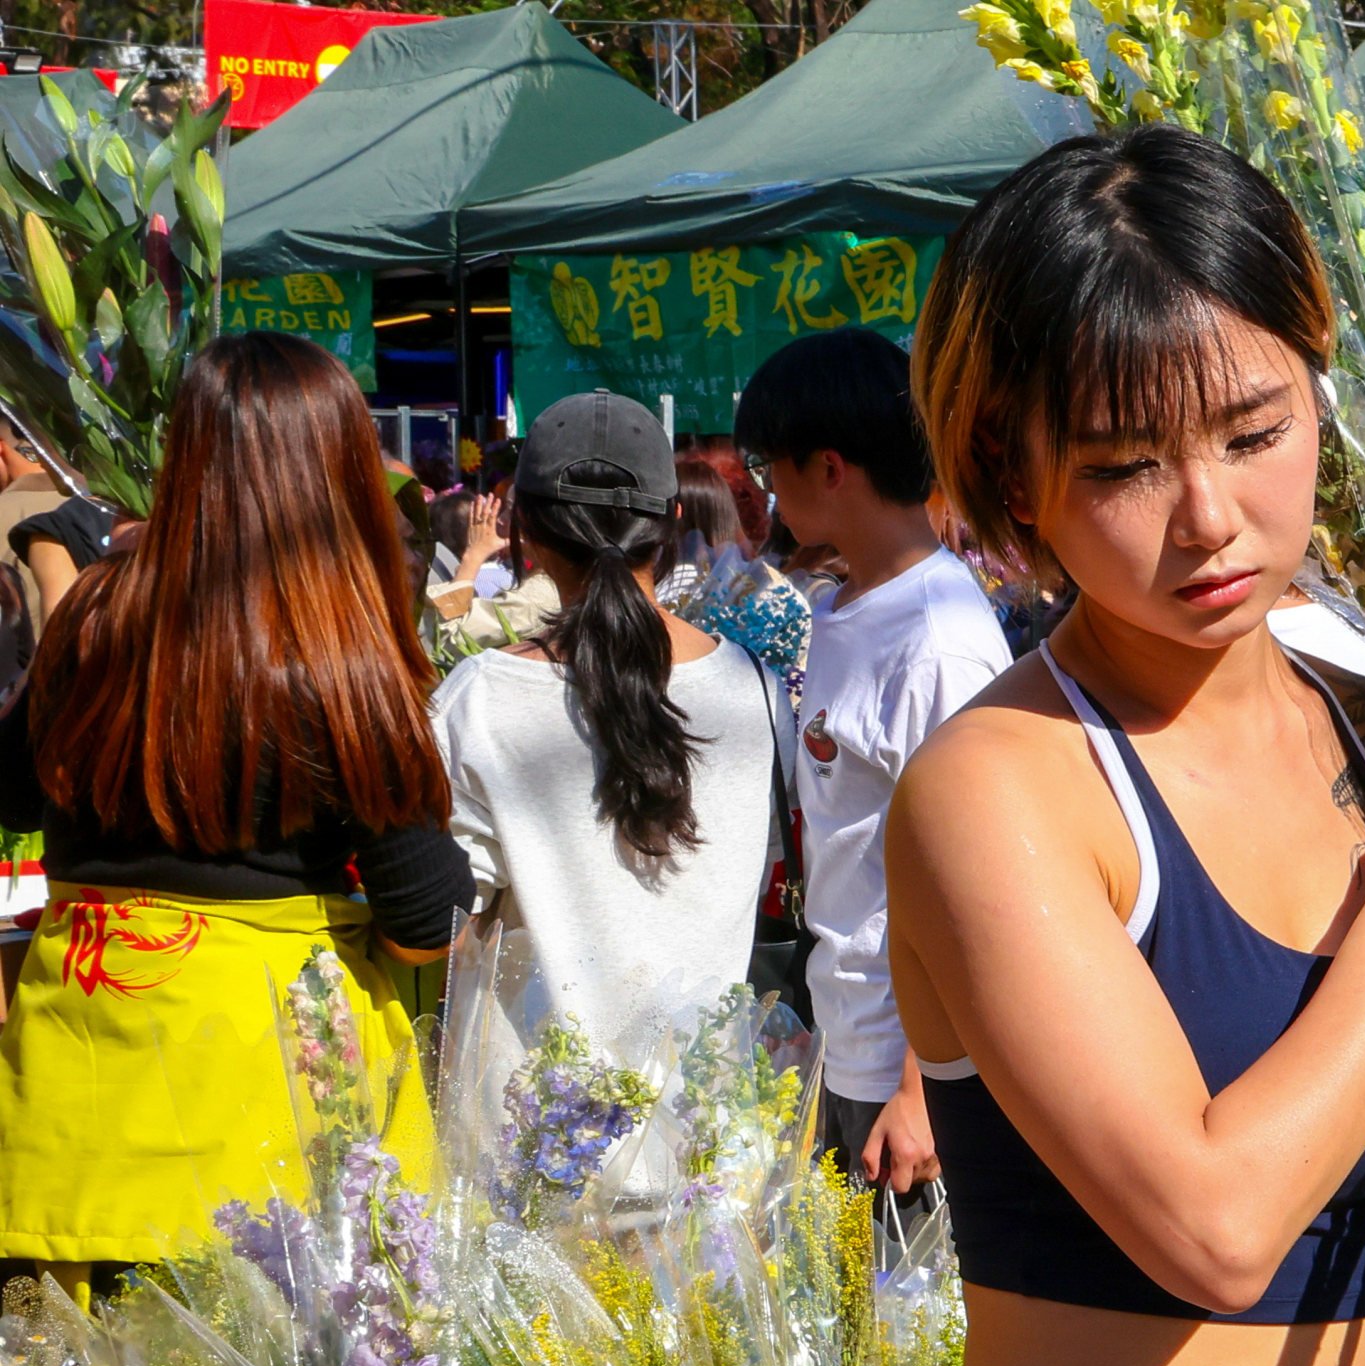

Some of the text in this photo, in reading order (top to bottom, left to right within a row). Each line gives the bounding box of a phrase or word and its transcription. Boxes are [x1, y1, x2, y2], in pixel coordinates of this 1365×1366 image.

[219, 56, 311, 79] NO ENTRY
[609, 237, 918, 341] 智賢花園
[220, 307, 352, 330] ARDEN
